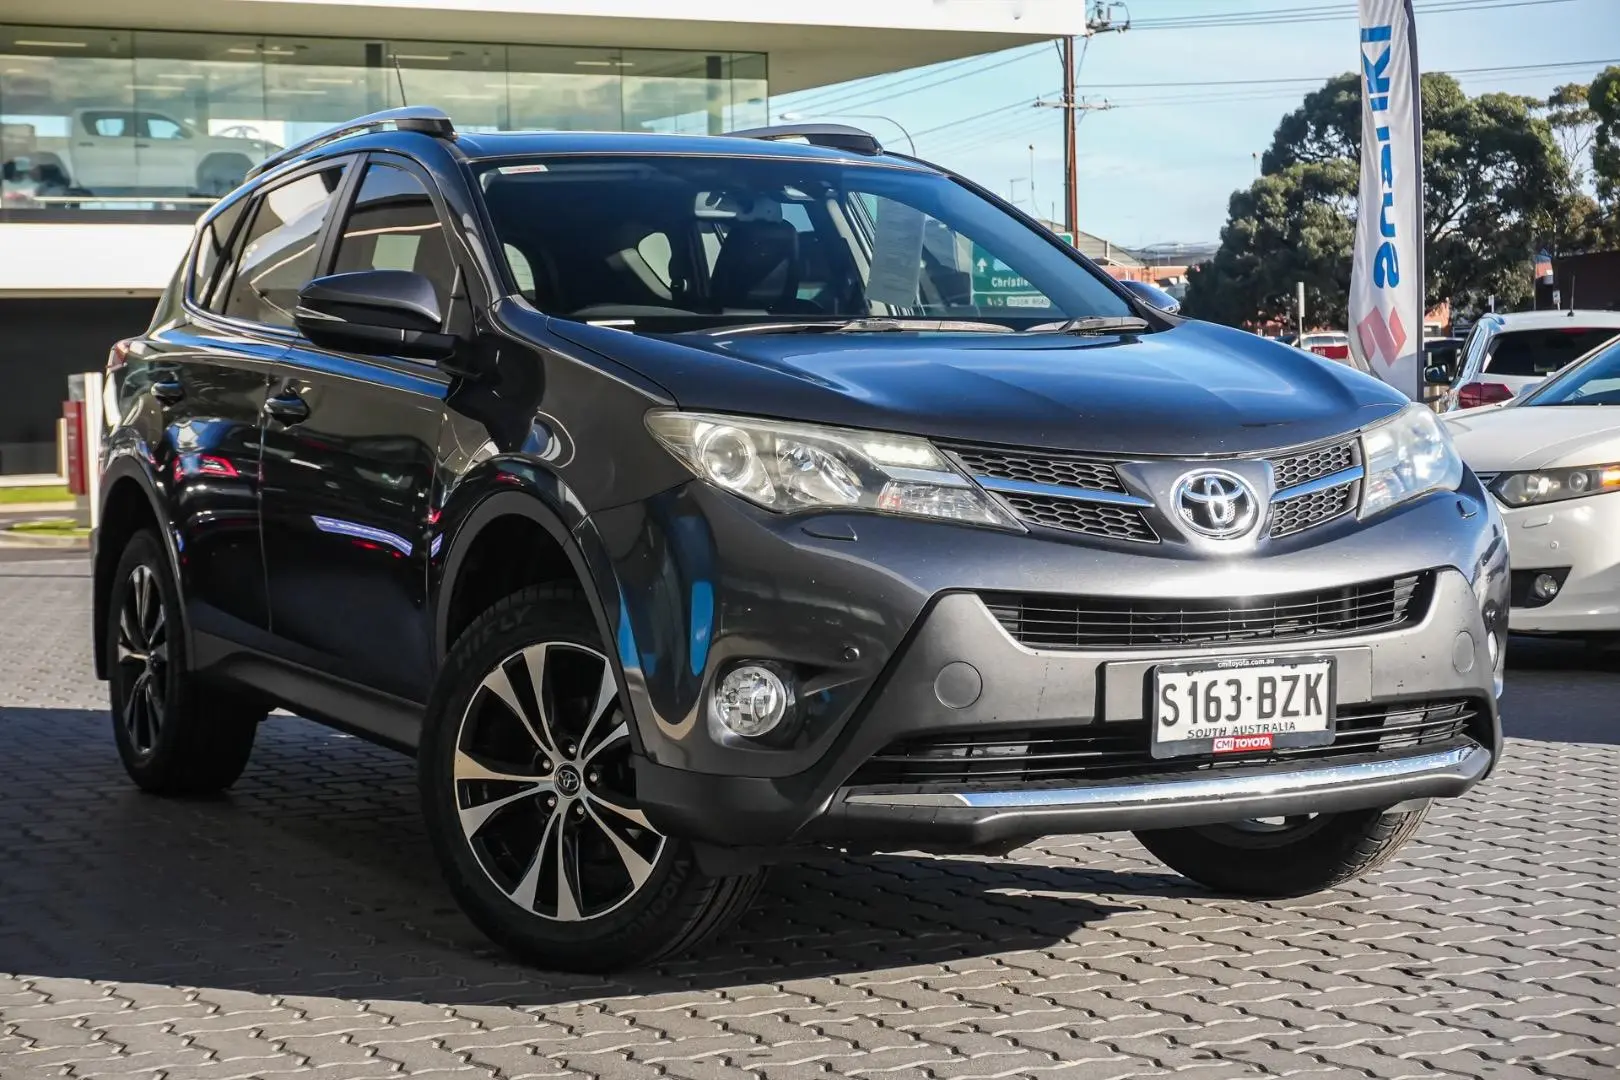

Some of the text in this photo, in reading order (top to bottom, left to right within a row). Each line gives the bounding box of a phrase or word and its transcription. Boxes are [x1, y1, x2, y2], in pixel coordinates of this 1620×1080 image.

[1187, 722, 1296, 739] SOUTH AUSTRALIA
[1215, 736, 1271, 751] CMI TOYOTA
